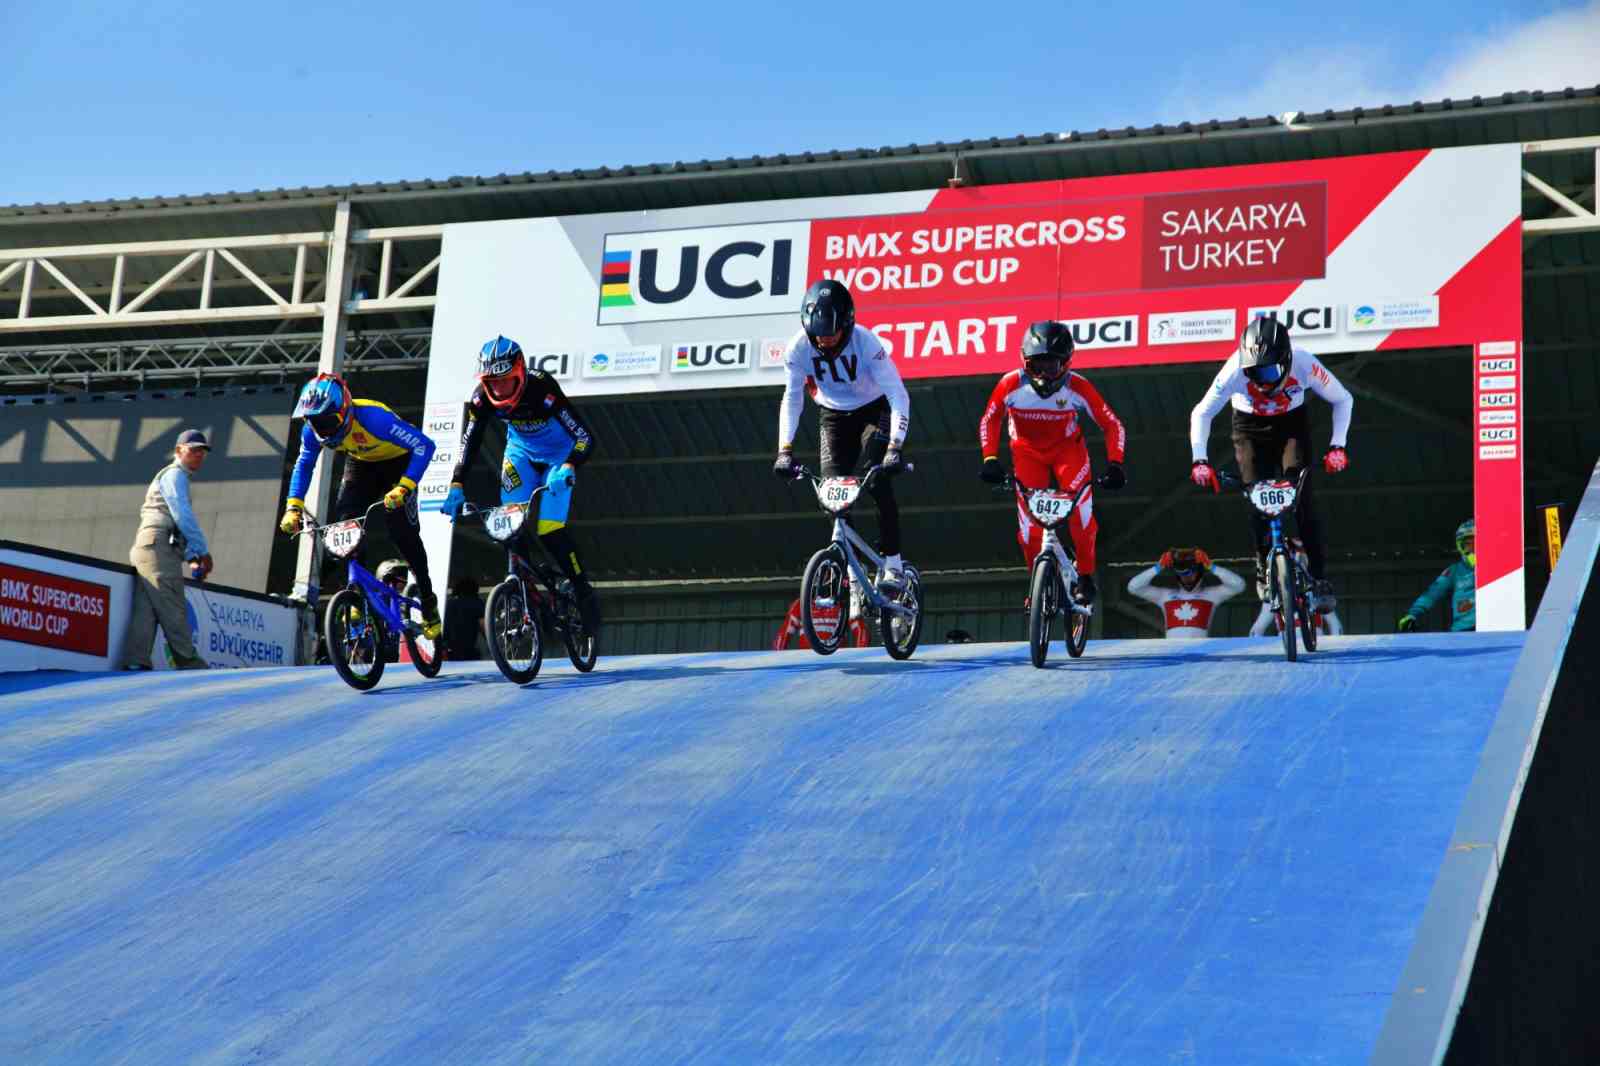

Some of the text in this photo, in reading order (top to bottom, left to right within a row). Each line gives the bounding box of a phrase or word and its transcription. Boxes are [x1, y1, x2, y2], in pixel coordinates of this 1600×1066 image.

[1161, 201, 1306, 237] SAKARYA
[825, 215, 1127, 260] BMX SUPERCROSS
[1159, 237, 1285, 272] TURKEY
[639, 239, 793, 304] UCI
[952, 257, 1019, 286] CUP
[870, 315, 1018, 358] START
[1072, 320, 1132, 345] UCI
[690, 343, 746, 367] UCI
[1487, 361, 1513, 370] UCI
[812, 354, 857, 383] FLY
[1487, 395, 1513, 405] UCI
[433, 421, 455, 431] UCI
[1487, 430, 1513, 440] UCI
[427, 485, 448, 494] UCI
[828, 487, 849, 501] 636
[1260, 490, 1285, 506] 666
[1036, 500, 1060, 515] 642
[493, 517, 512, 531] 641
[333, 531, 352, 543] 674
[1, 578, 104, 617] BMX SUPERCROSS
[0, 604, 70, 636] WORLD CUP
[210, 602, 265, 632] SAKARYA
[210, 631, 284, 665] BÜYÜKŞEHİR
